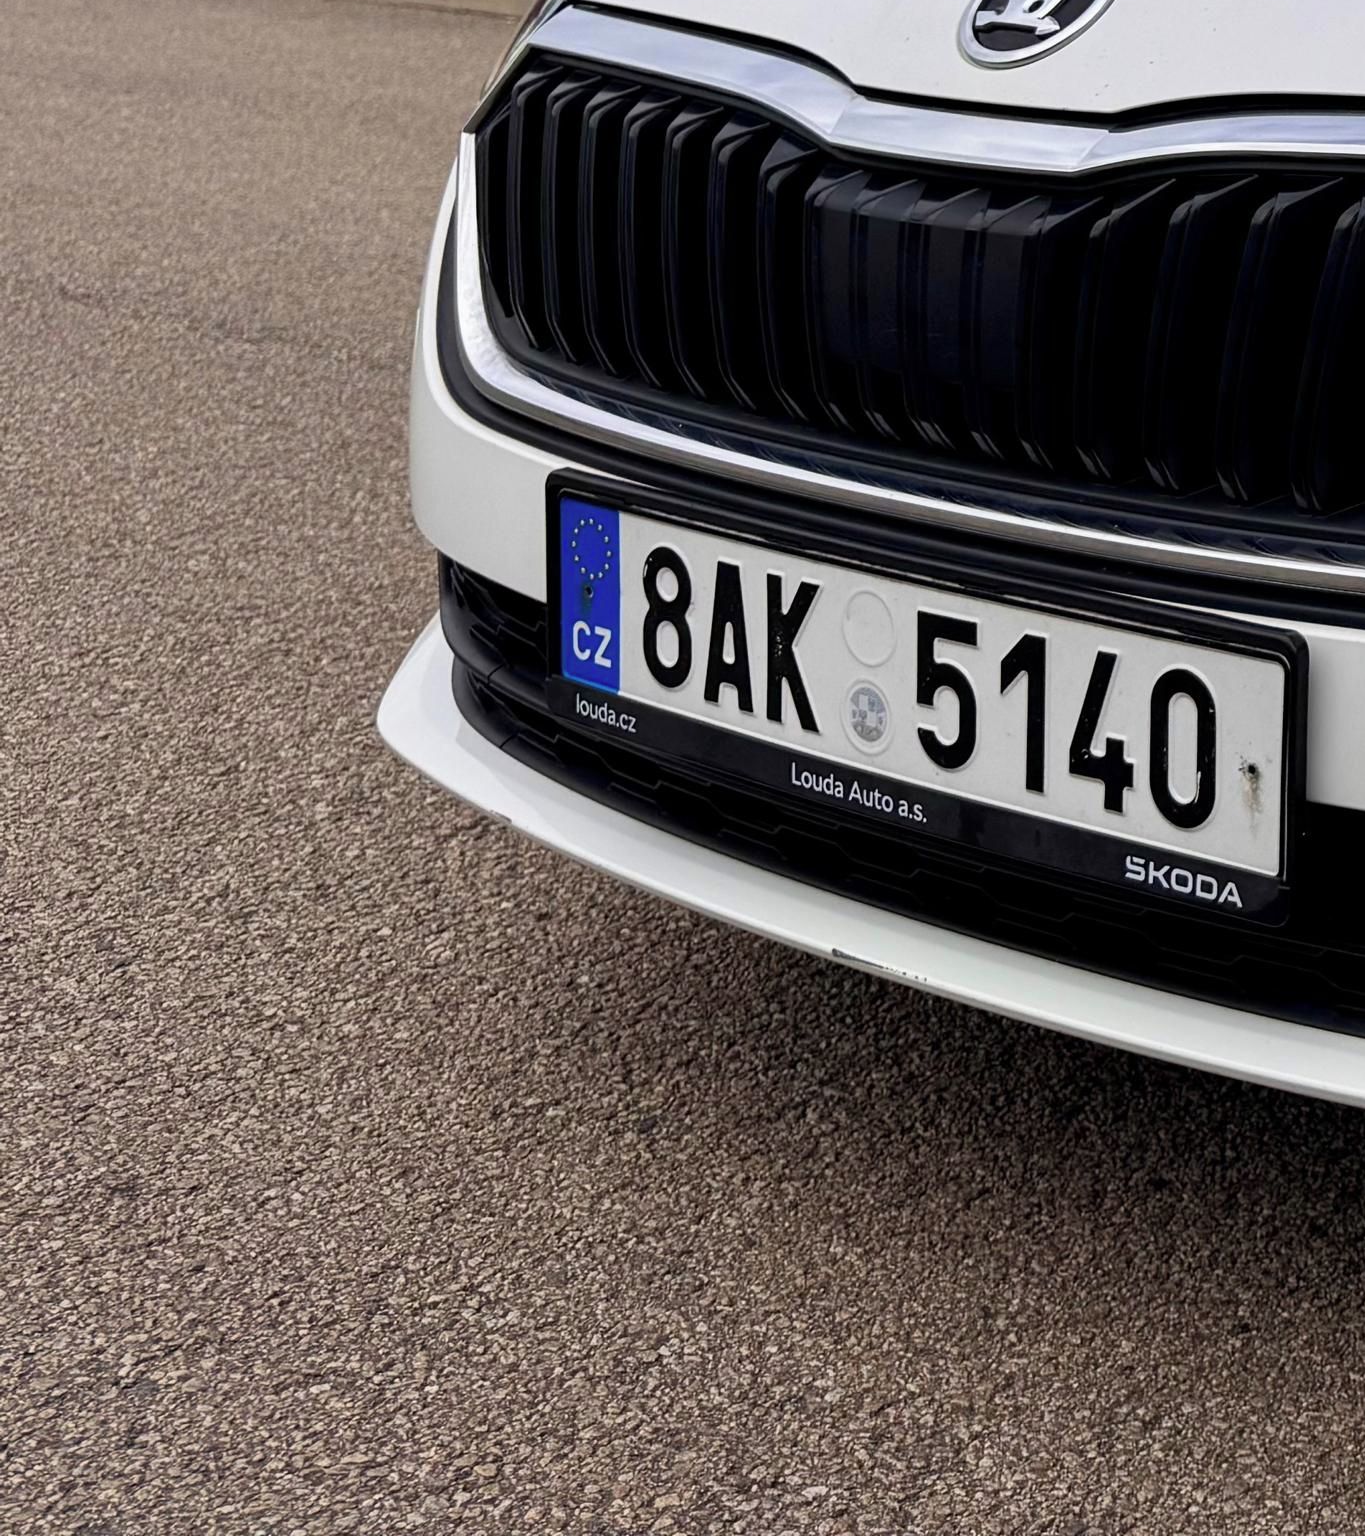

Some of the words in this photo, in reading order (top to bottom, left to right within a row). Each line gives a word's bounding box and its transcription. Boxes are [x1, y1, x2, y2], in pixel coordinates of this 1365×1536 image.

[572, 620, 612, 668] CZ
[576, 692, 637, 734] louda.cz
[643, 546, 820, 734] 8AK
[917, 610, 1216, 829] 5140
[791, 762, 844, 798] Louda
[848, 780, 894, 813] Auto
[898, 800, 928, 823] a.s.
